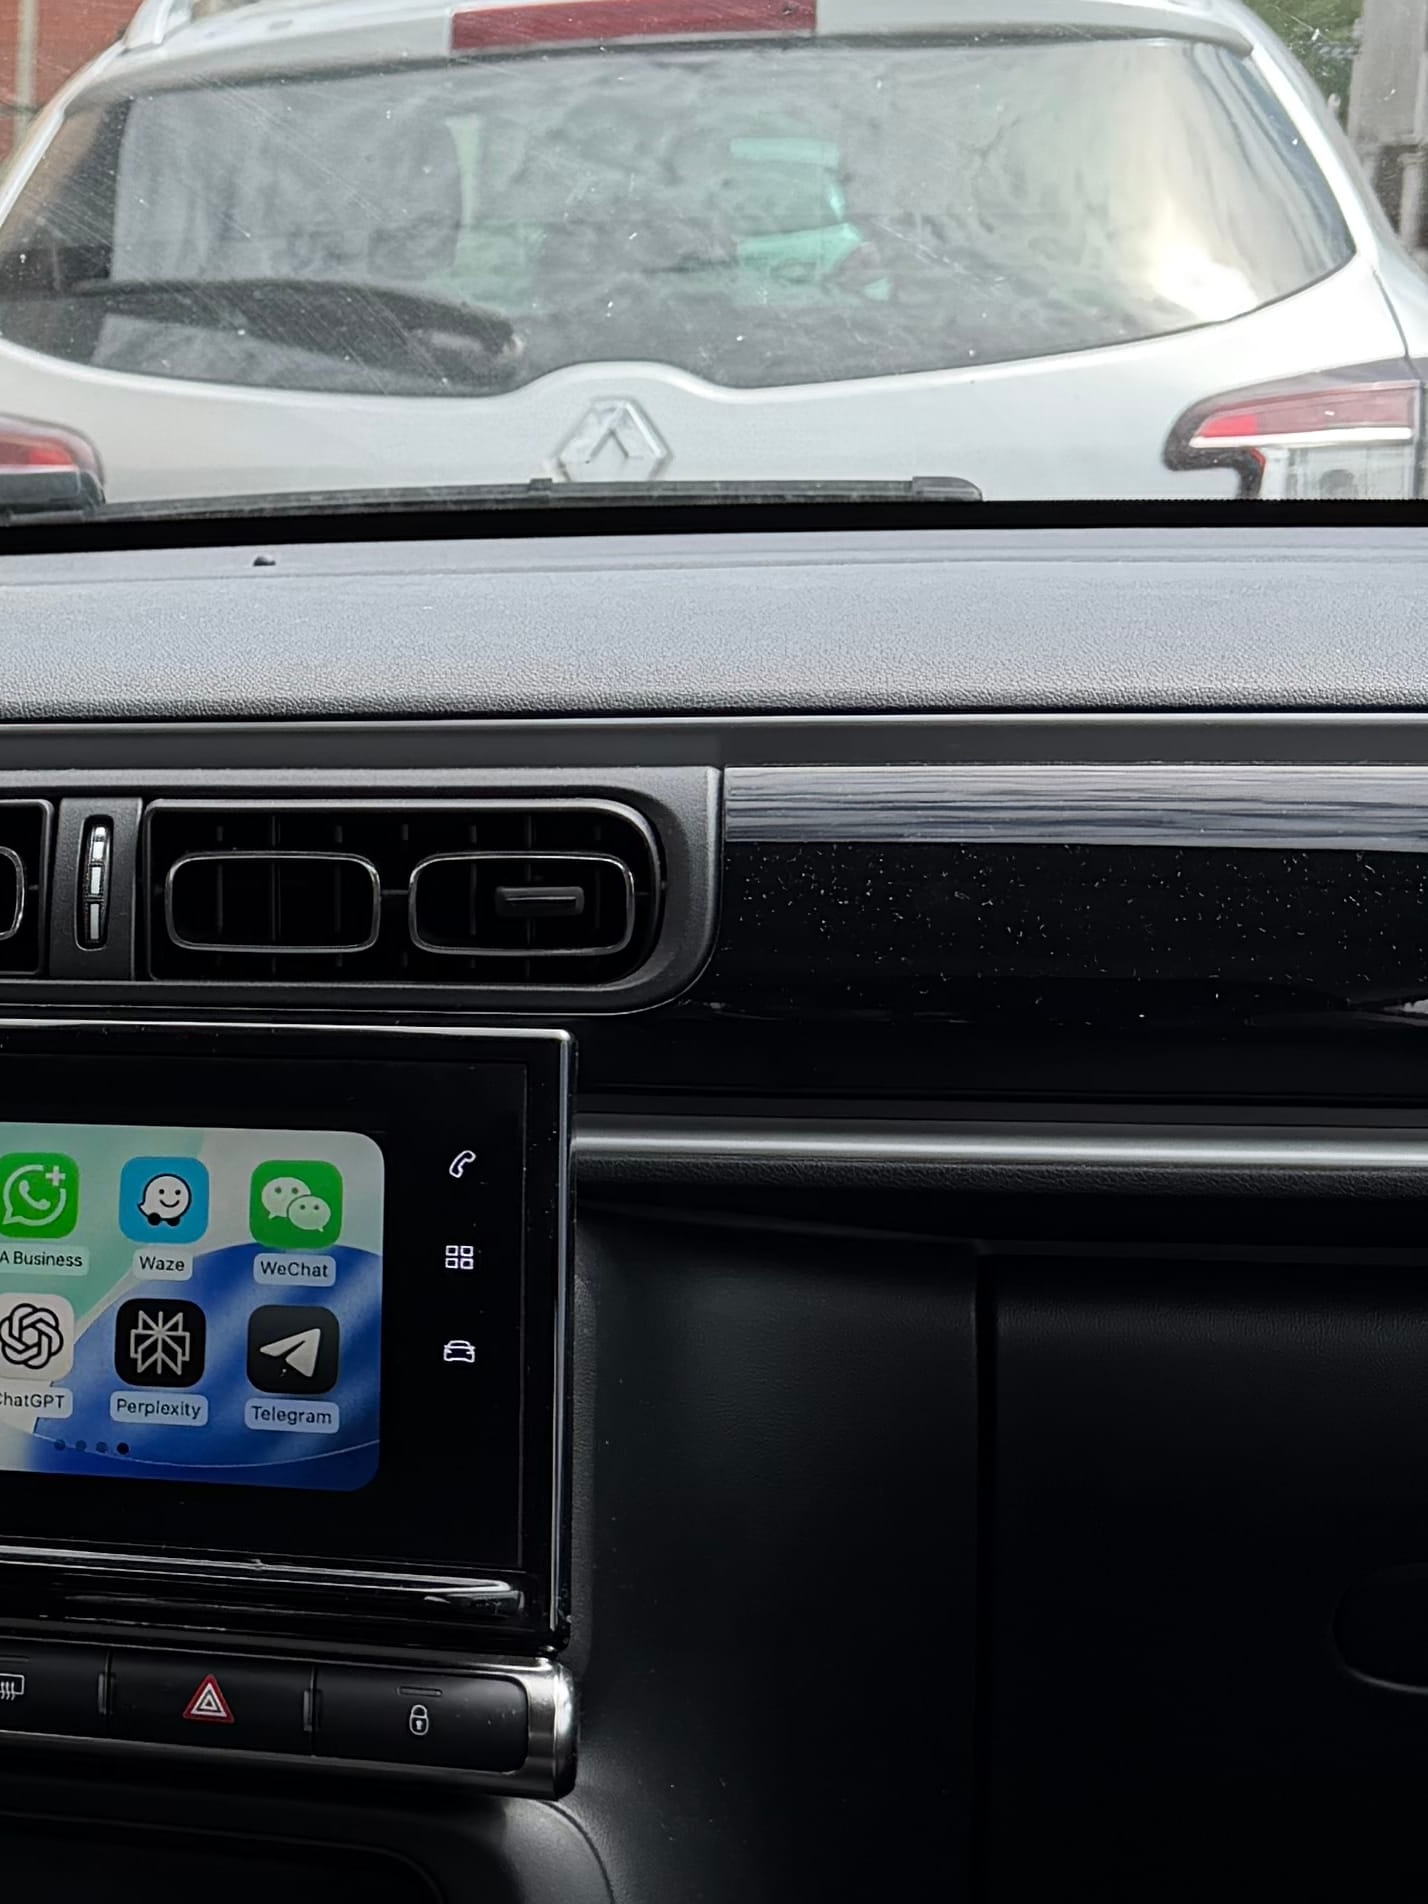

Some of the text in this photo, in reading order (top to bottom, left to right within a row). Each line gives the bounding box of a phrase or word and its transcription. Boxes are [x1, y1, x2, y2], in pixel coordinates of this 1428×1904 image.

[13, 1251, 82, 1267] Business
[139, 1256, 185, 1272] Waze
[260, 1262, 328, 1278] WeChat
[116, 1398, 201, 1419] Perplexity
[251, 1406, 332, 1426] Telegram
